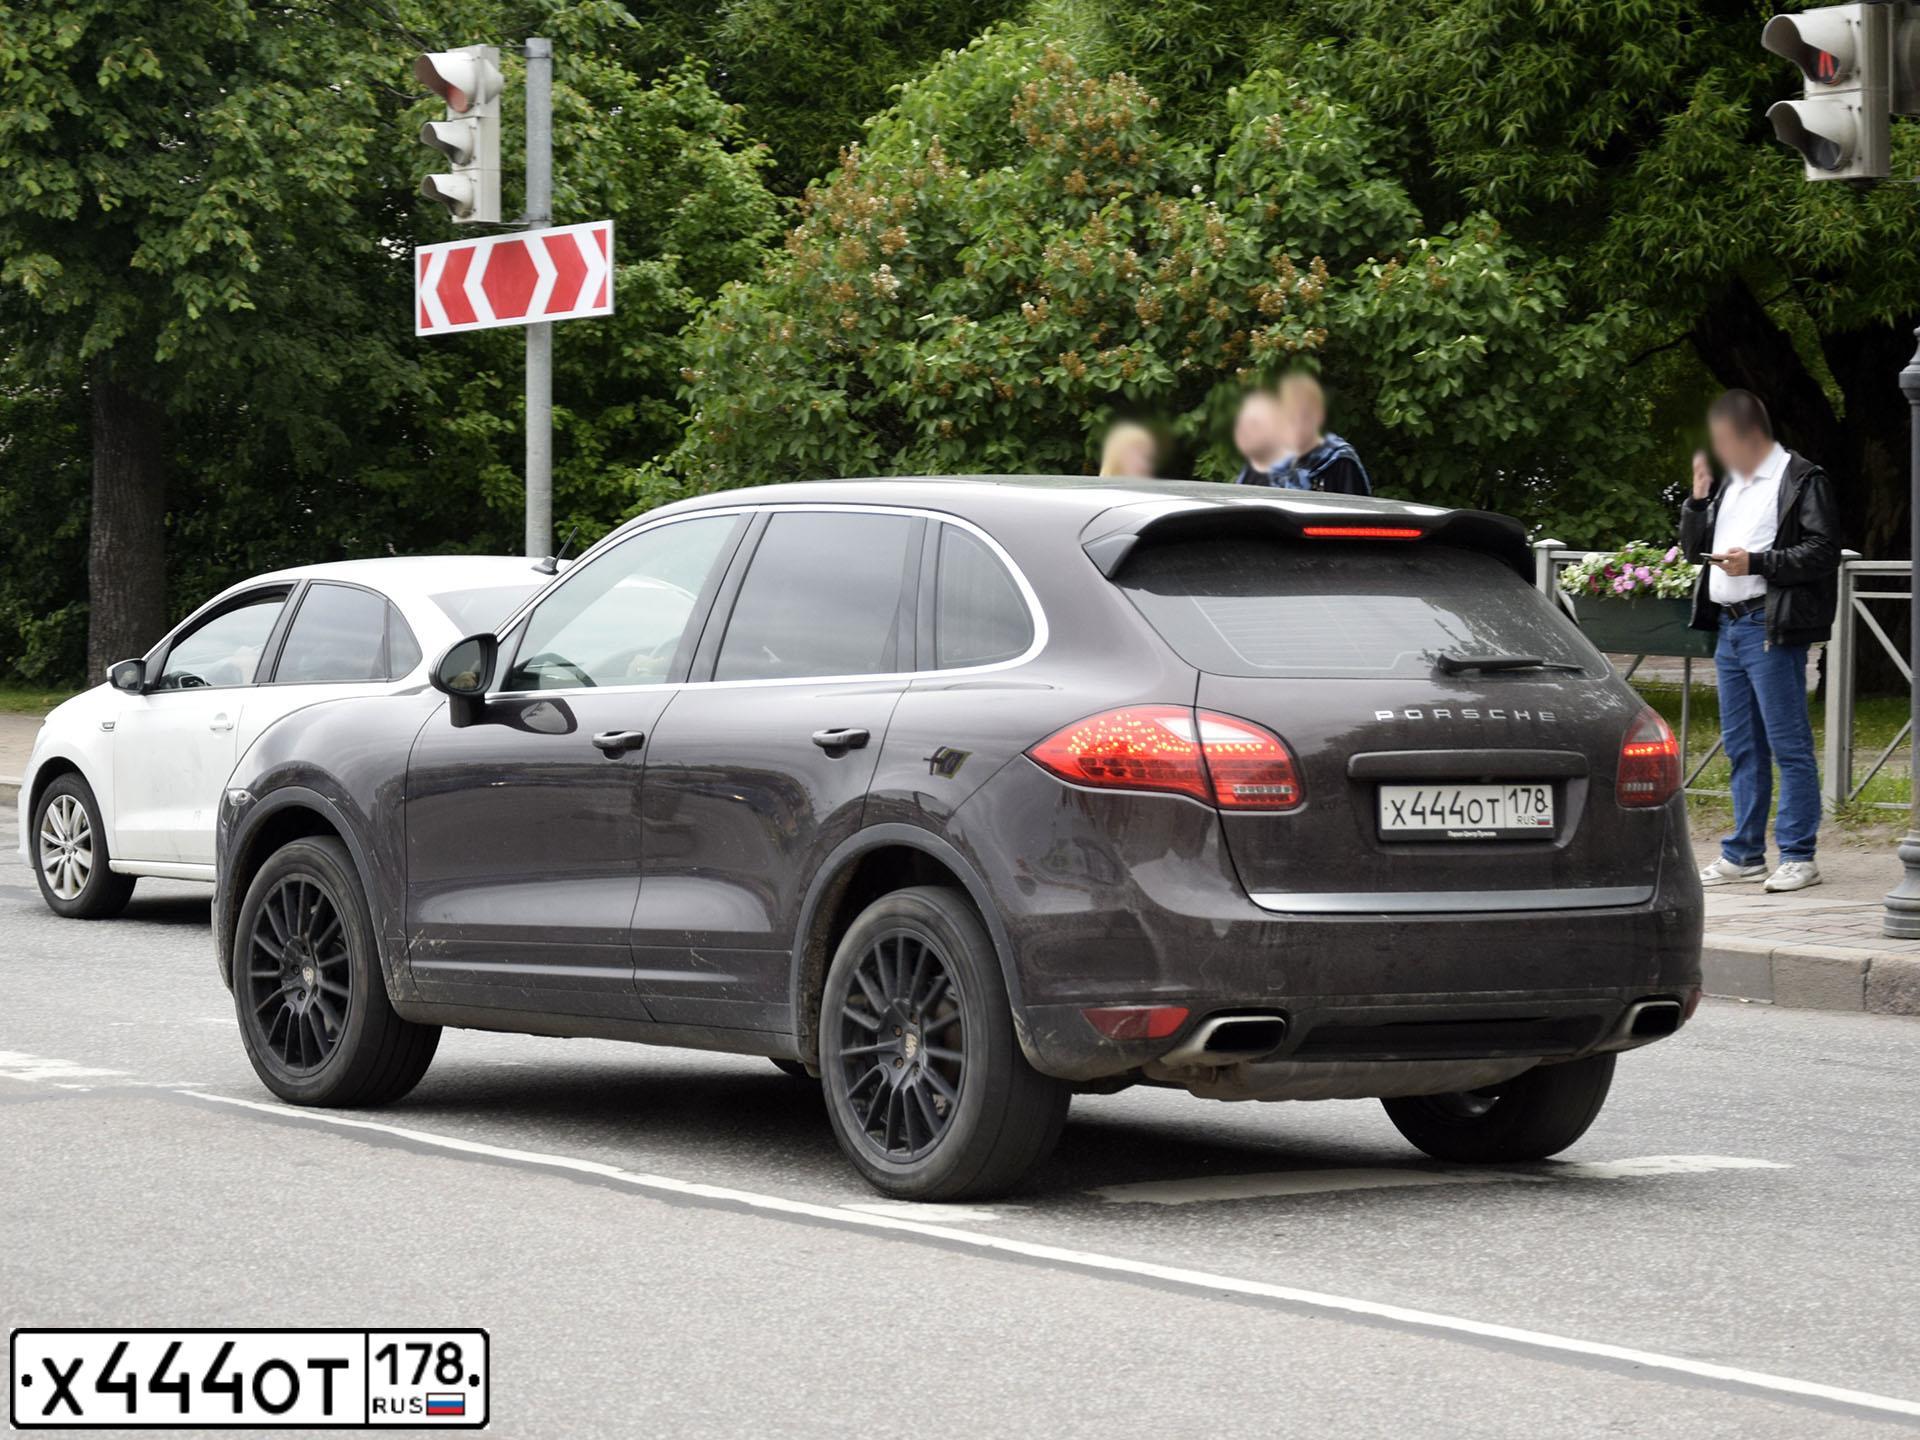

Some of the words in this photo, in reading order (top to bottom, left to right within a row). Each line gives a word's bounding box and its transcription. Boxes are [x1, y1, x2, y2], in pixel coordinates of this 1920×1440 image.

[1375, 709, 1557, 722] PORSCHE
[1508, 787, 1547, 815] 178
[1517, 815, 1537, 826] RUS
